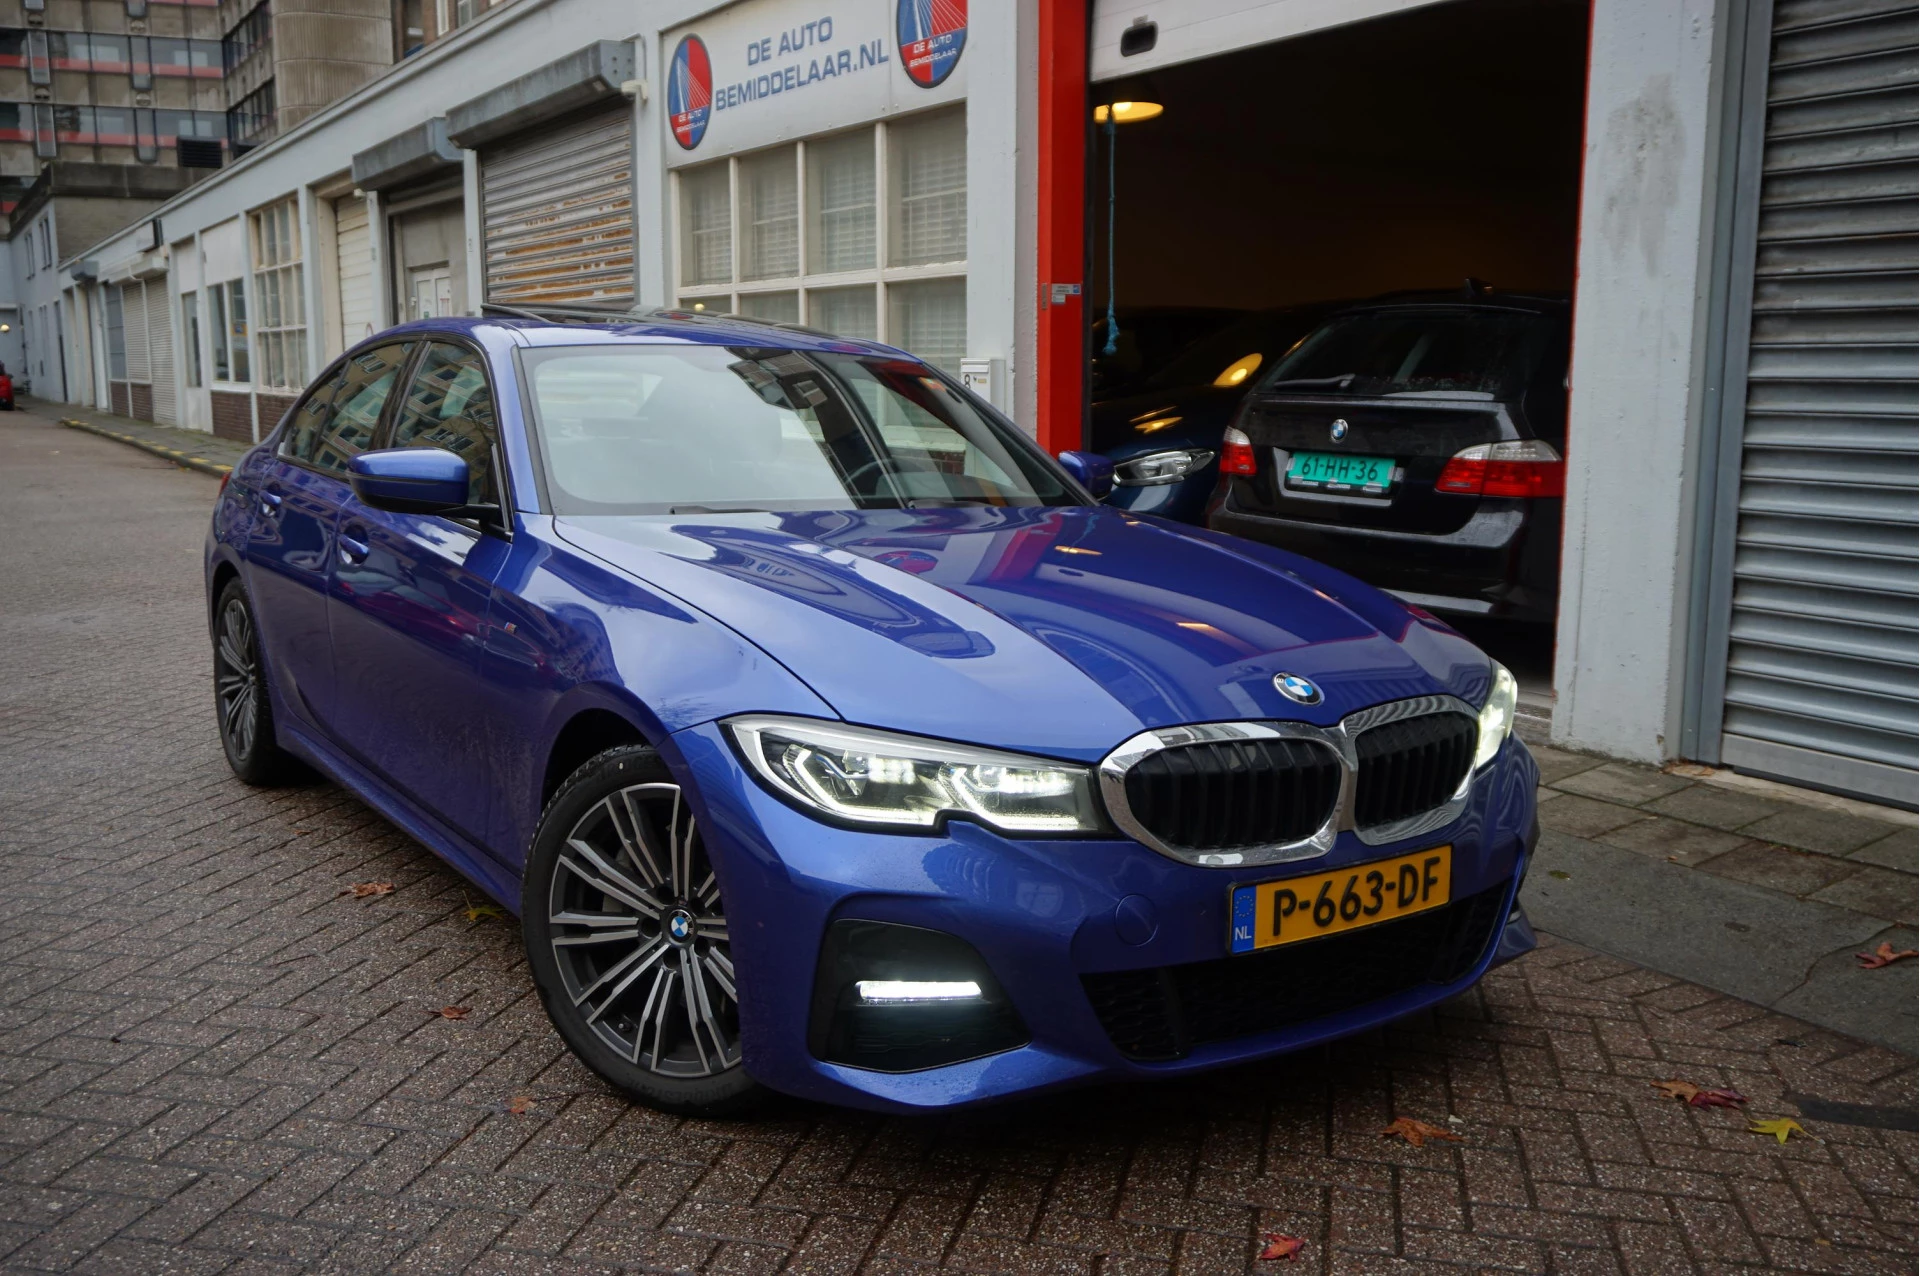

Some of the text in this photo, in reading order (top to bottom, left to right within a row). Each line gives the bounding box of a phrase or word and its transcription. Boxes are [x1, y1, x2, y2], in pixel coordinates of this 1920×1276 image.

[748, 16, 833, 66] DE AUTO
[913, 34, 952, 54] DE AUTO
[715, 38, 889, 111] BEMIDDELAAR.NL
[1302, 456, 1379, 481] 61-HH-36
[1273, 856, 1440, 937] P-663-DF
[1234, 925, 1252, 941] NL
